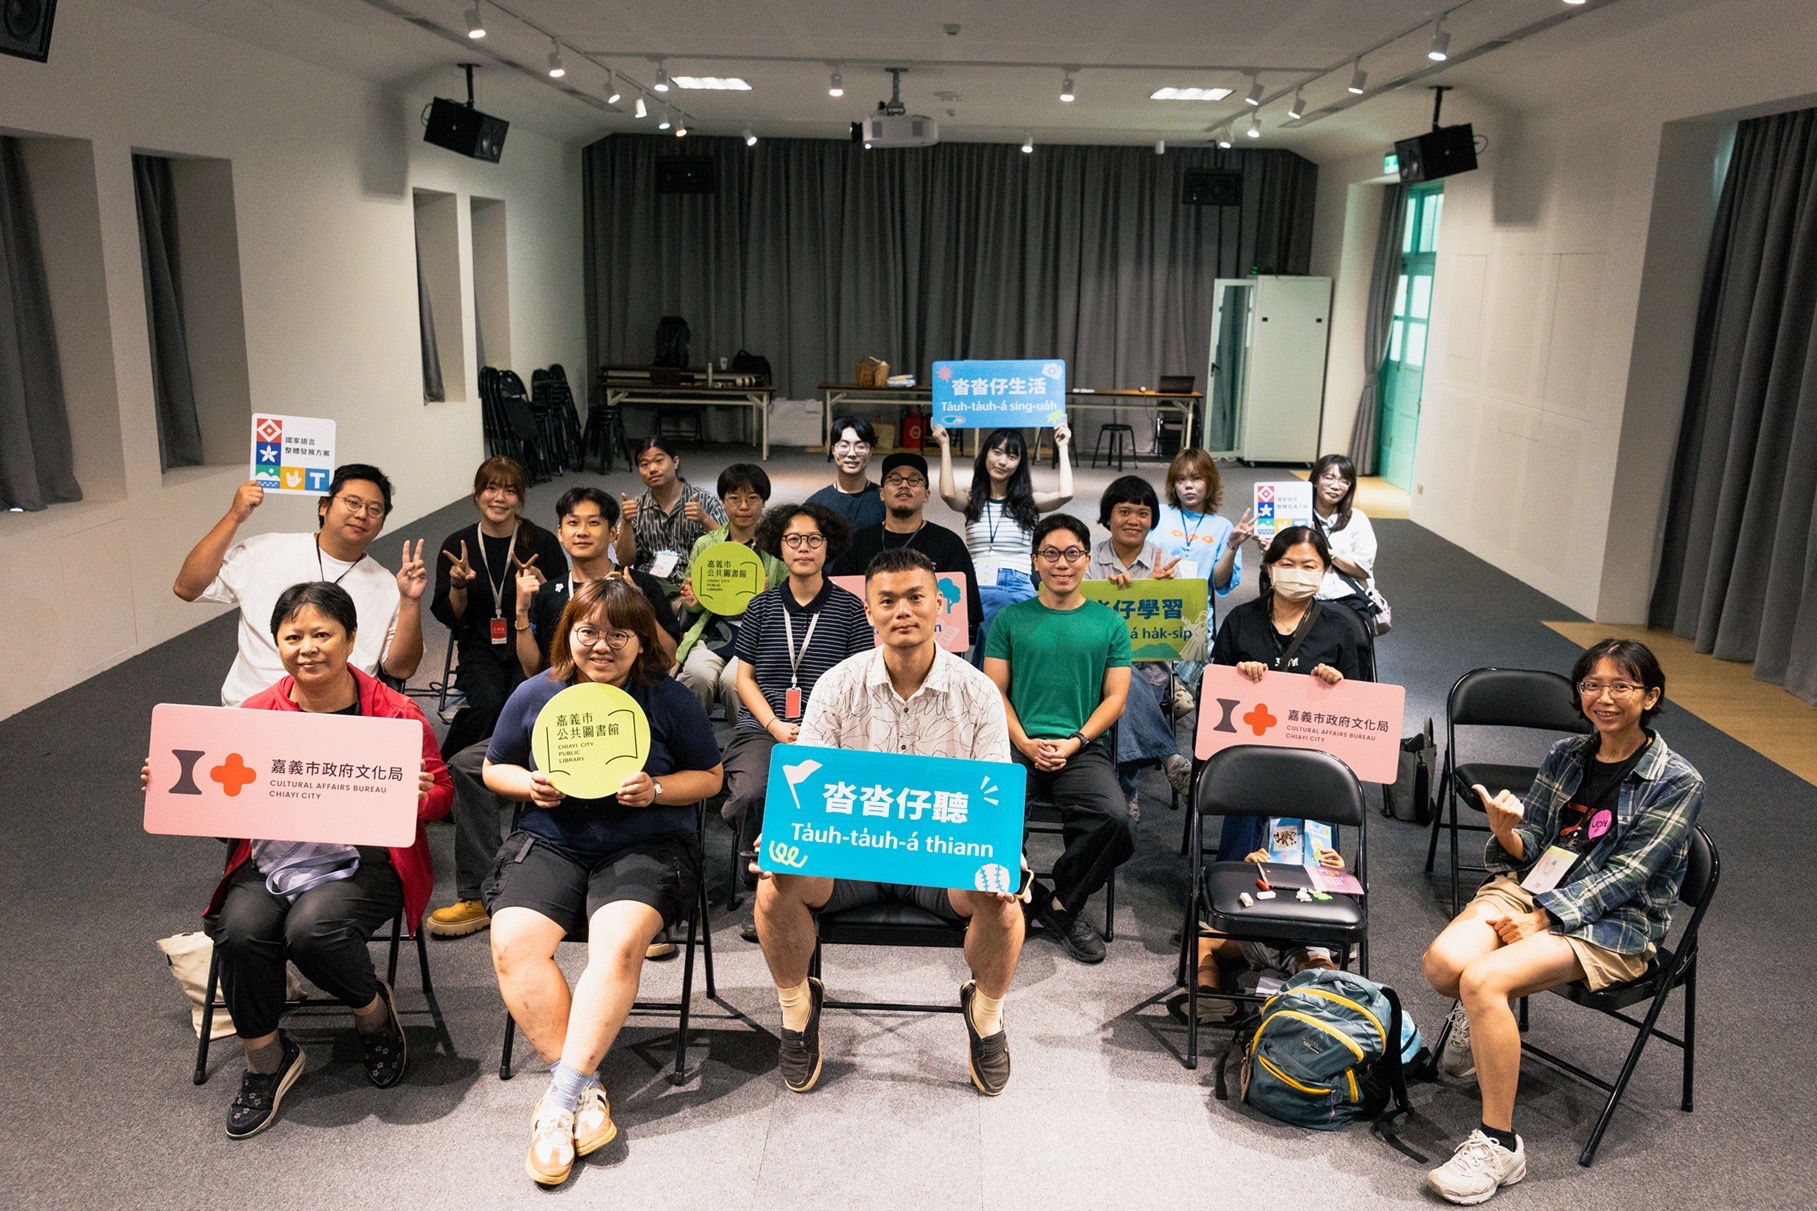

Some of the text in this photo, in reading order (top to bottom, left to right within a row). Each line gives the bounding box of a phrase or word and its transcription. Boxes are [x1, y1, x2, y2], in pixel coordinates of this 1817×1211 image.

[952, 377, 1046, 396] 沓沓仔生活
[285, 436, 315, 445] 國家語言
[285, 447, 330, 457] 整體發展方案
[708, 560, 731, 568] 嘉義市
[708, 569, 747, 578] 公共圖書館
[556, 712, 593, 726] 嘉義市
[1287, 709, 1389, 733] 嘉義市政府文化局
[557, 723, 619, 740] 公共圖書館
[1285, 733, 1308, 741] CHIAYI
[1286, 725, 1376, 741] CULTURAL AFFAIRS BUREAU
[271, 758, 403, 782] 嘉義市政府文化局
[270, 780, 387, 793] CULTURAL AFFAIRS BUREAU
[269, 790, 299, 798] CHIAYI
[823, 781, 969, 824] 沓沓仔聽
[925, 835, 993, 857] thiann
